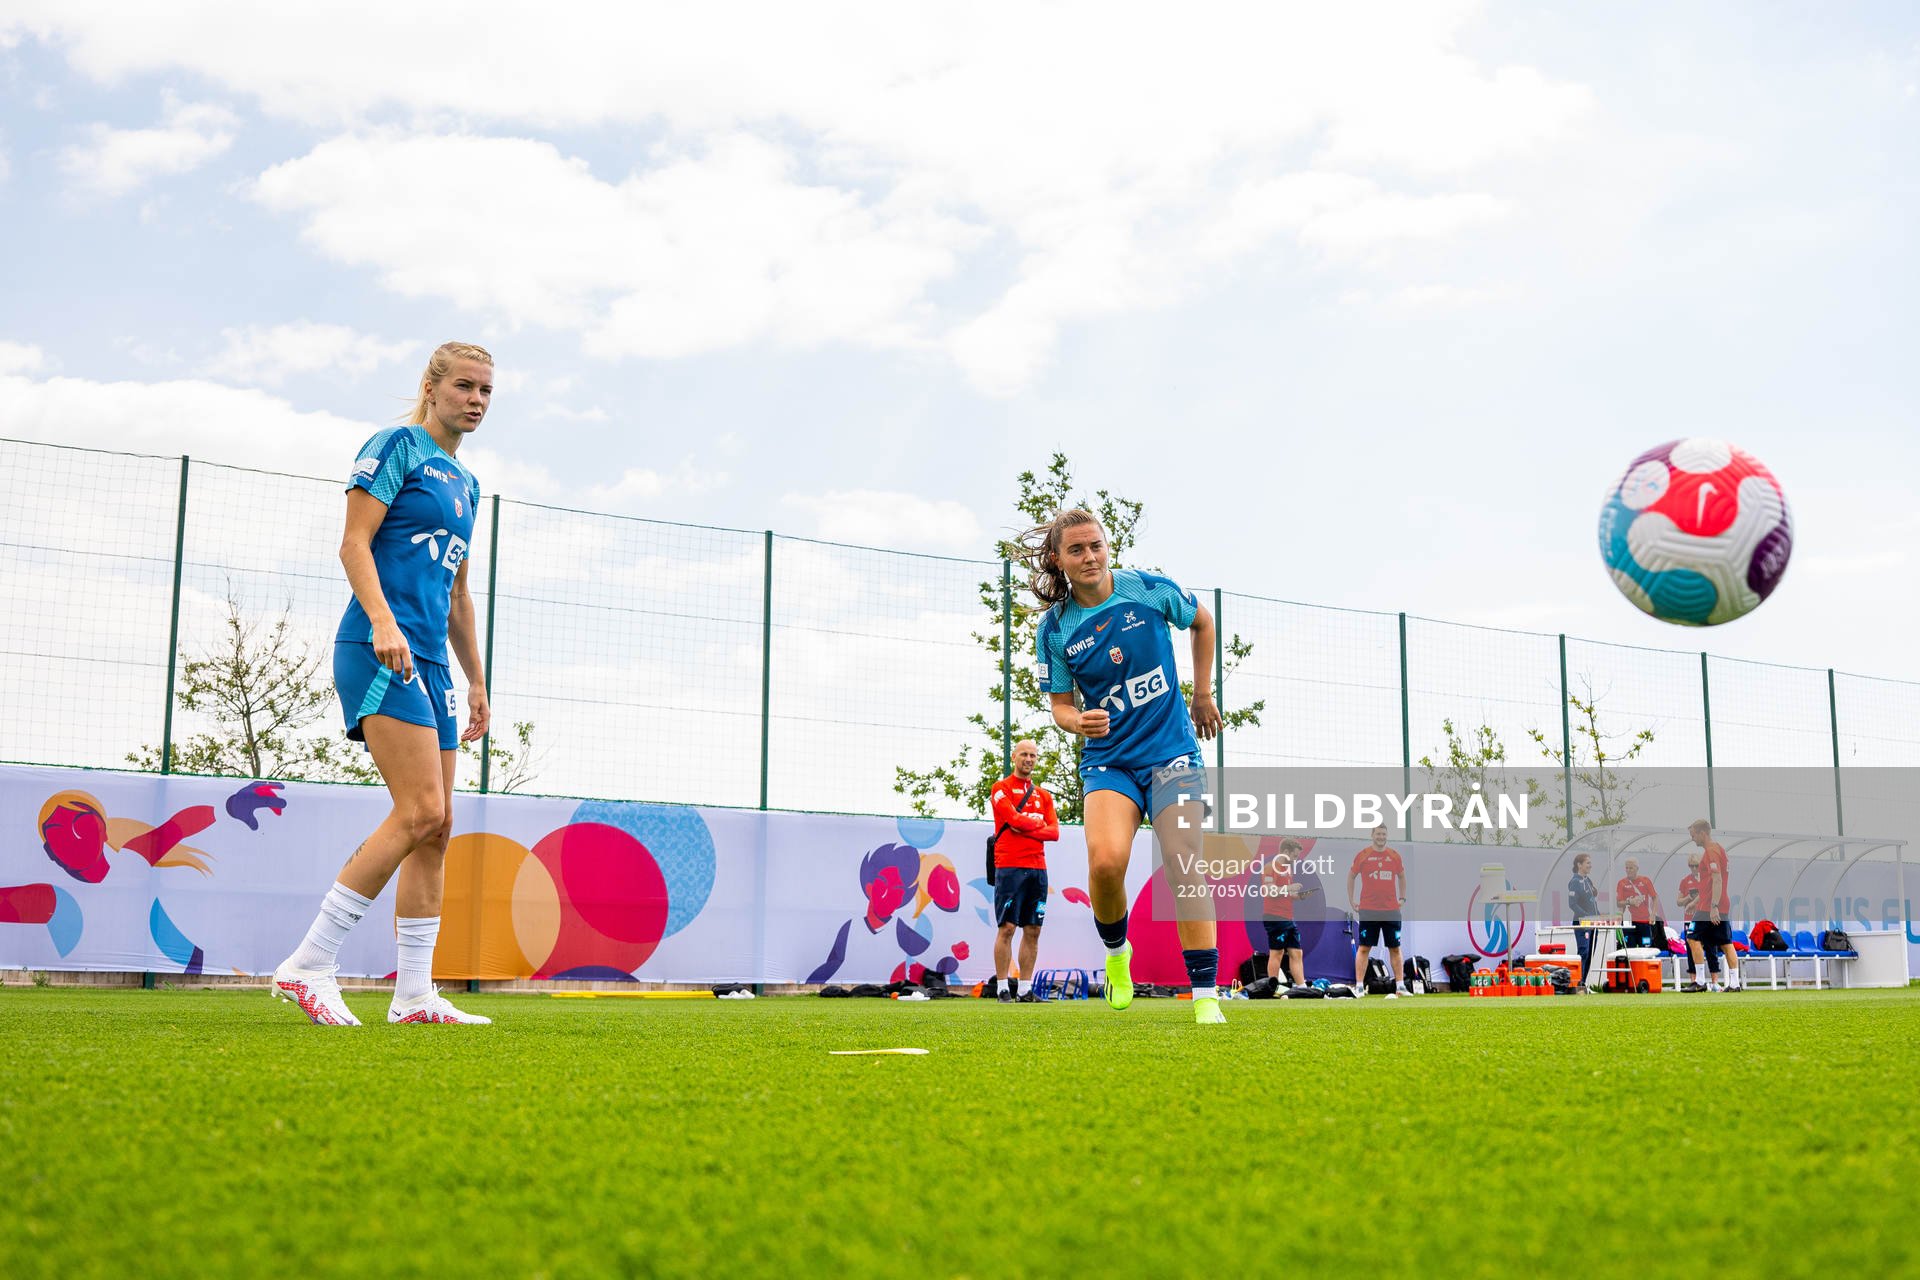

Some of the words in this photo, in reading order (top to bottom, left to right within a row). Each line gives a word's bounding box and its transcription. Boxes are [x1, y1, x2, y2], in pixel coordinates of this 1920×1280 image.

[424, 465, 442, 480] KIWI
[1066, 639, 1087, 656] KIWI
[1134, 673, 1163, 700] 5G
[1727, 894, 1873, 934] OMEN'S
